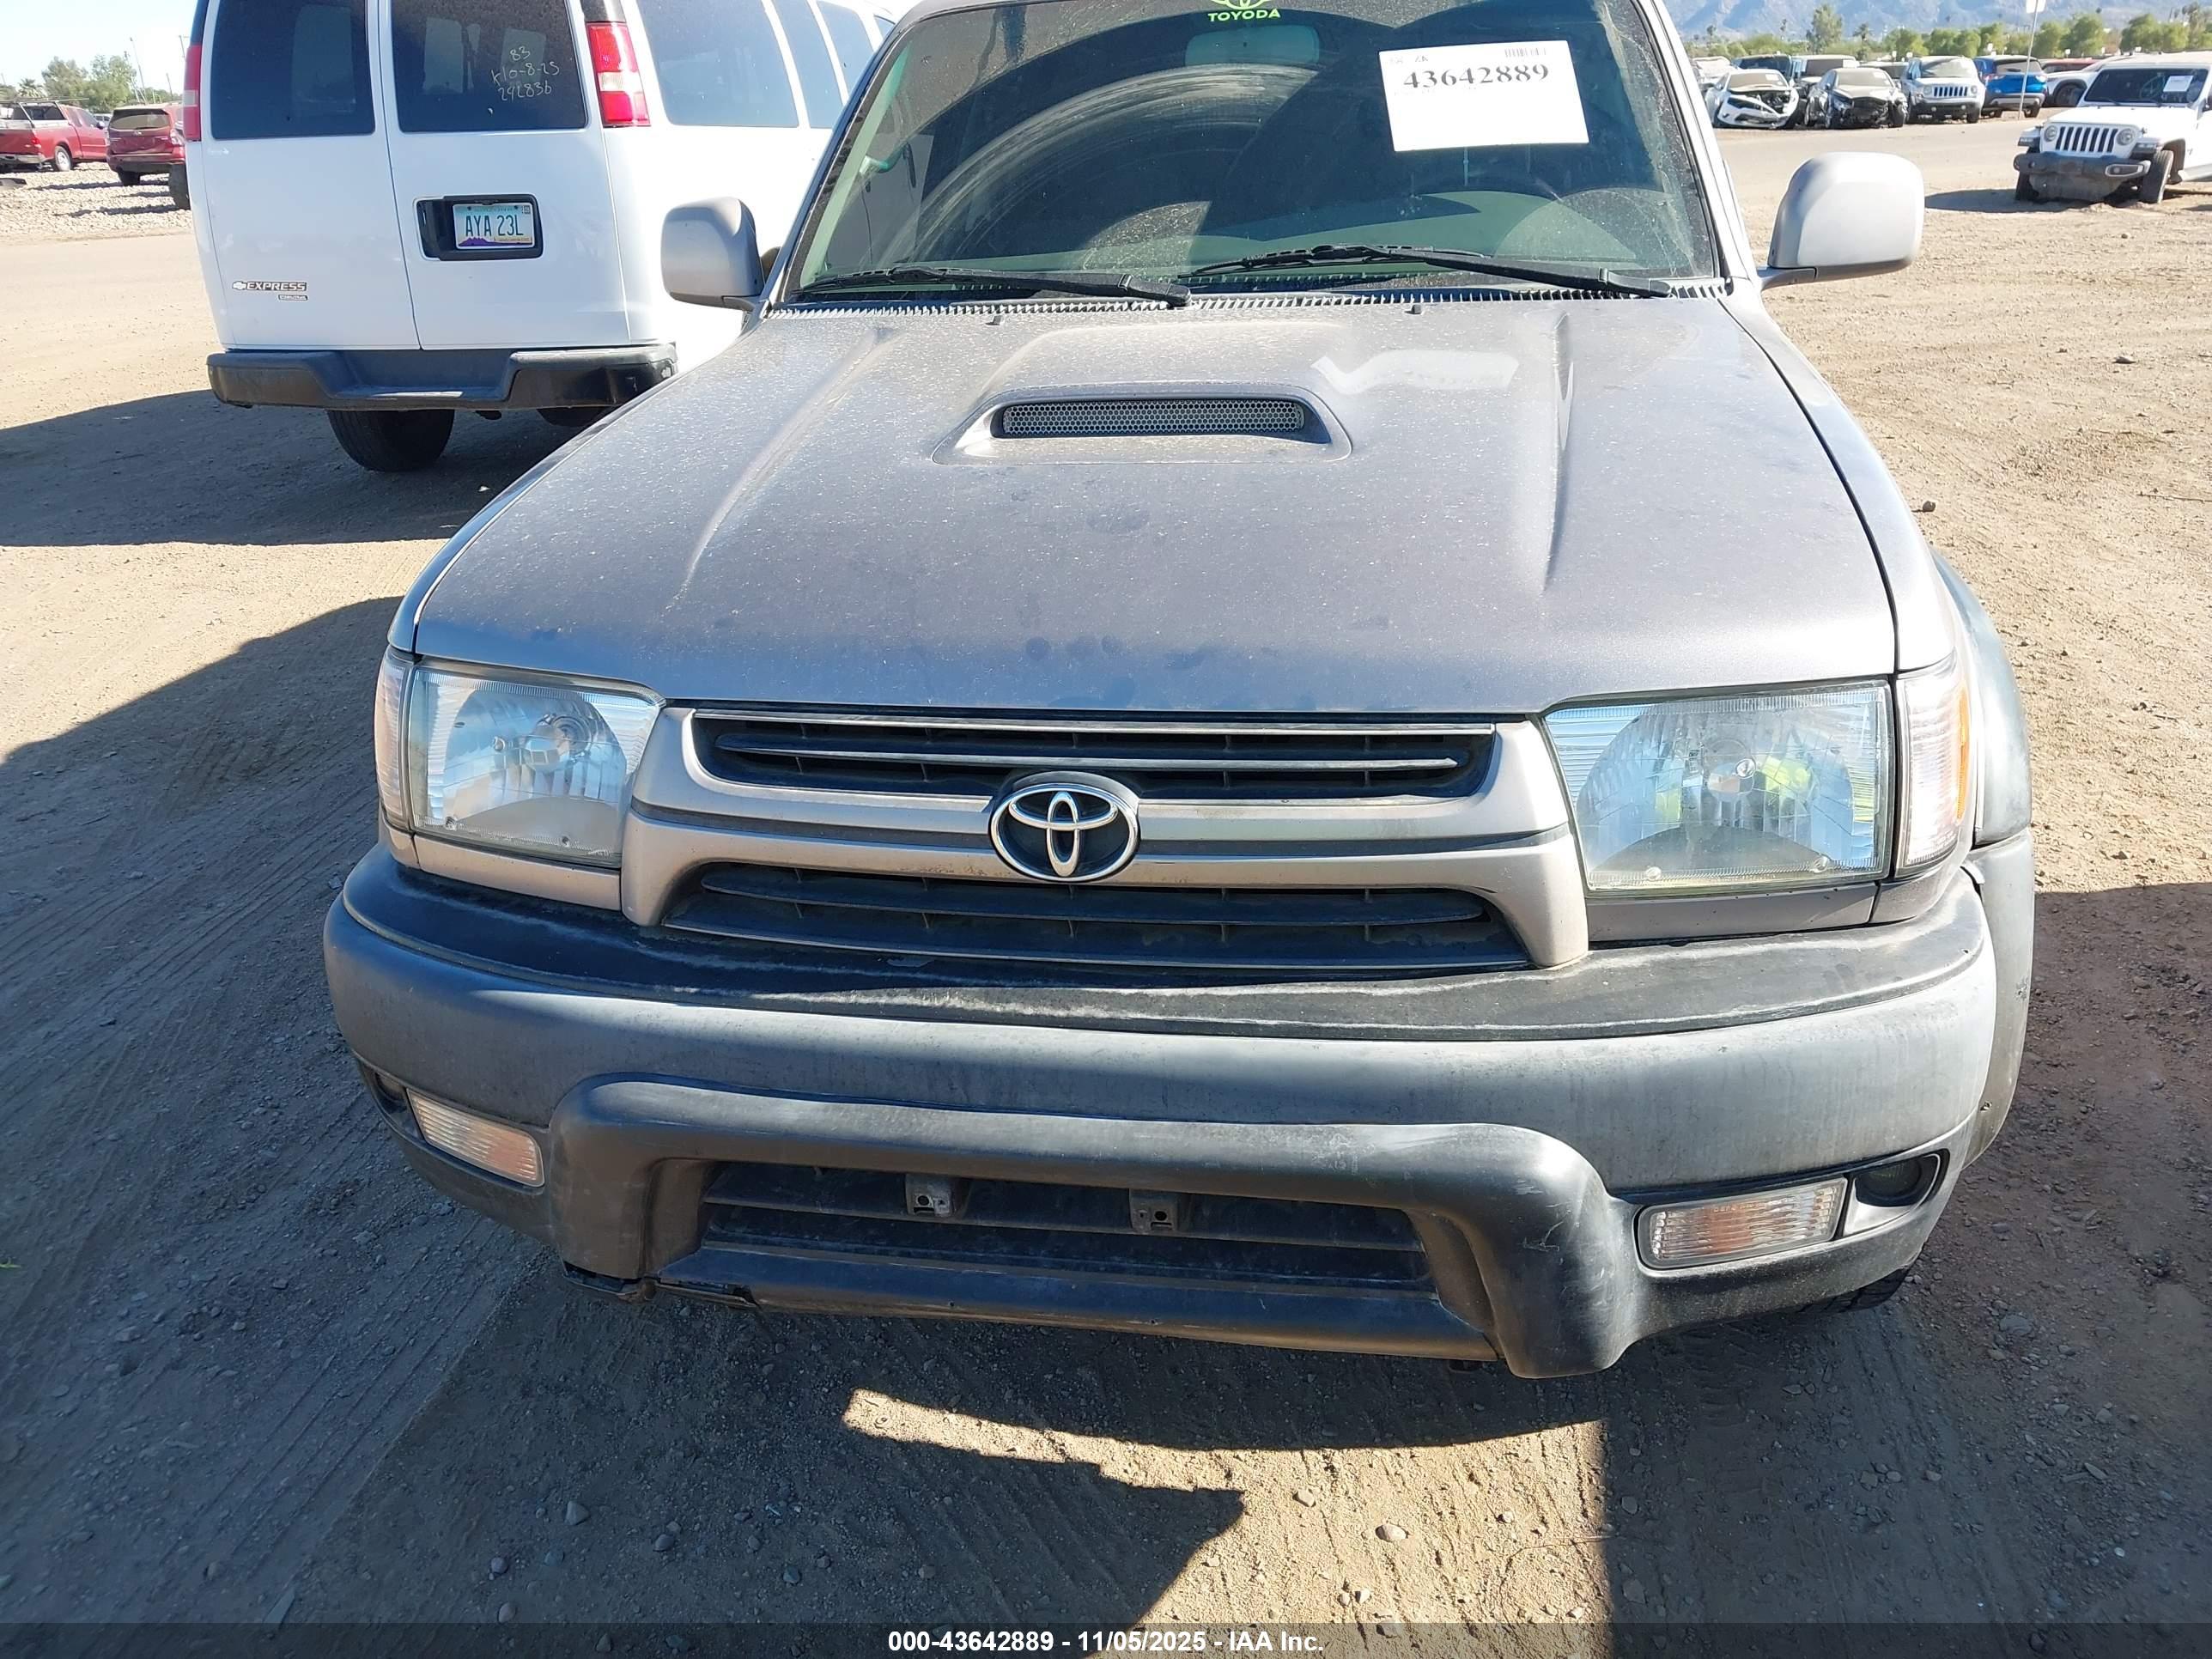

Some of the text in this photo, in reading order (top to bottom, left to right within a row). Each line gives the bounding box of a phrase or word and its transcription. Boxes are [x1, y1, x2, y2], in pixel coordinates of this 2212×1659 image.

[1207, 8, 1281, 22] TOYODA
[509, 46, 531, 61] 83
[1403, 64, 1549, 89] 43642889
[465, 214, 524, 237] AYA 23L
[246, 281, 307, 291] EXPRESS
